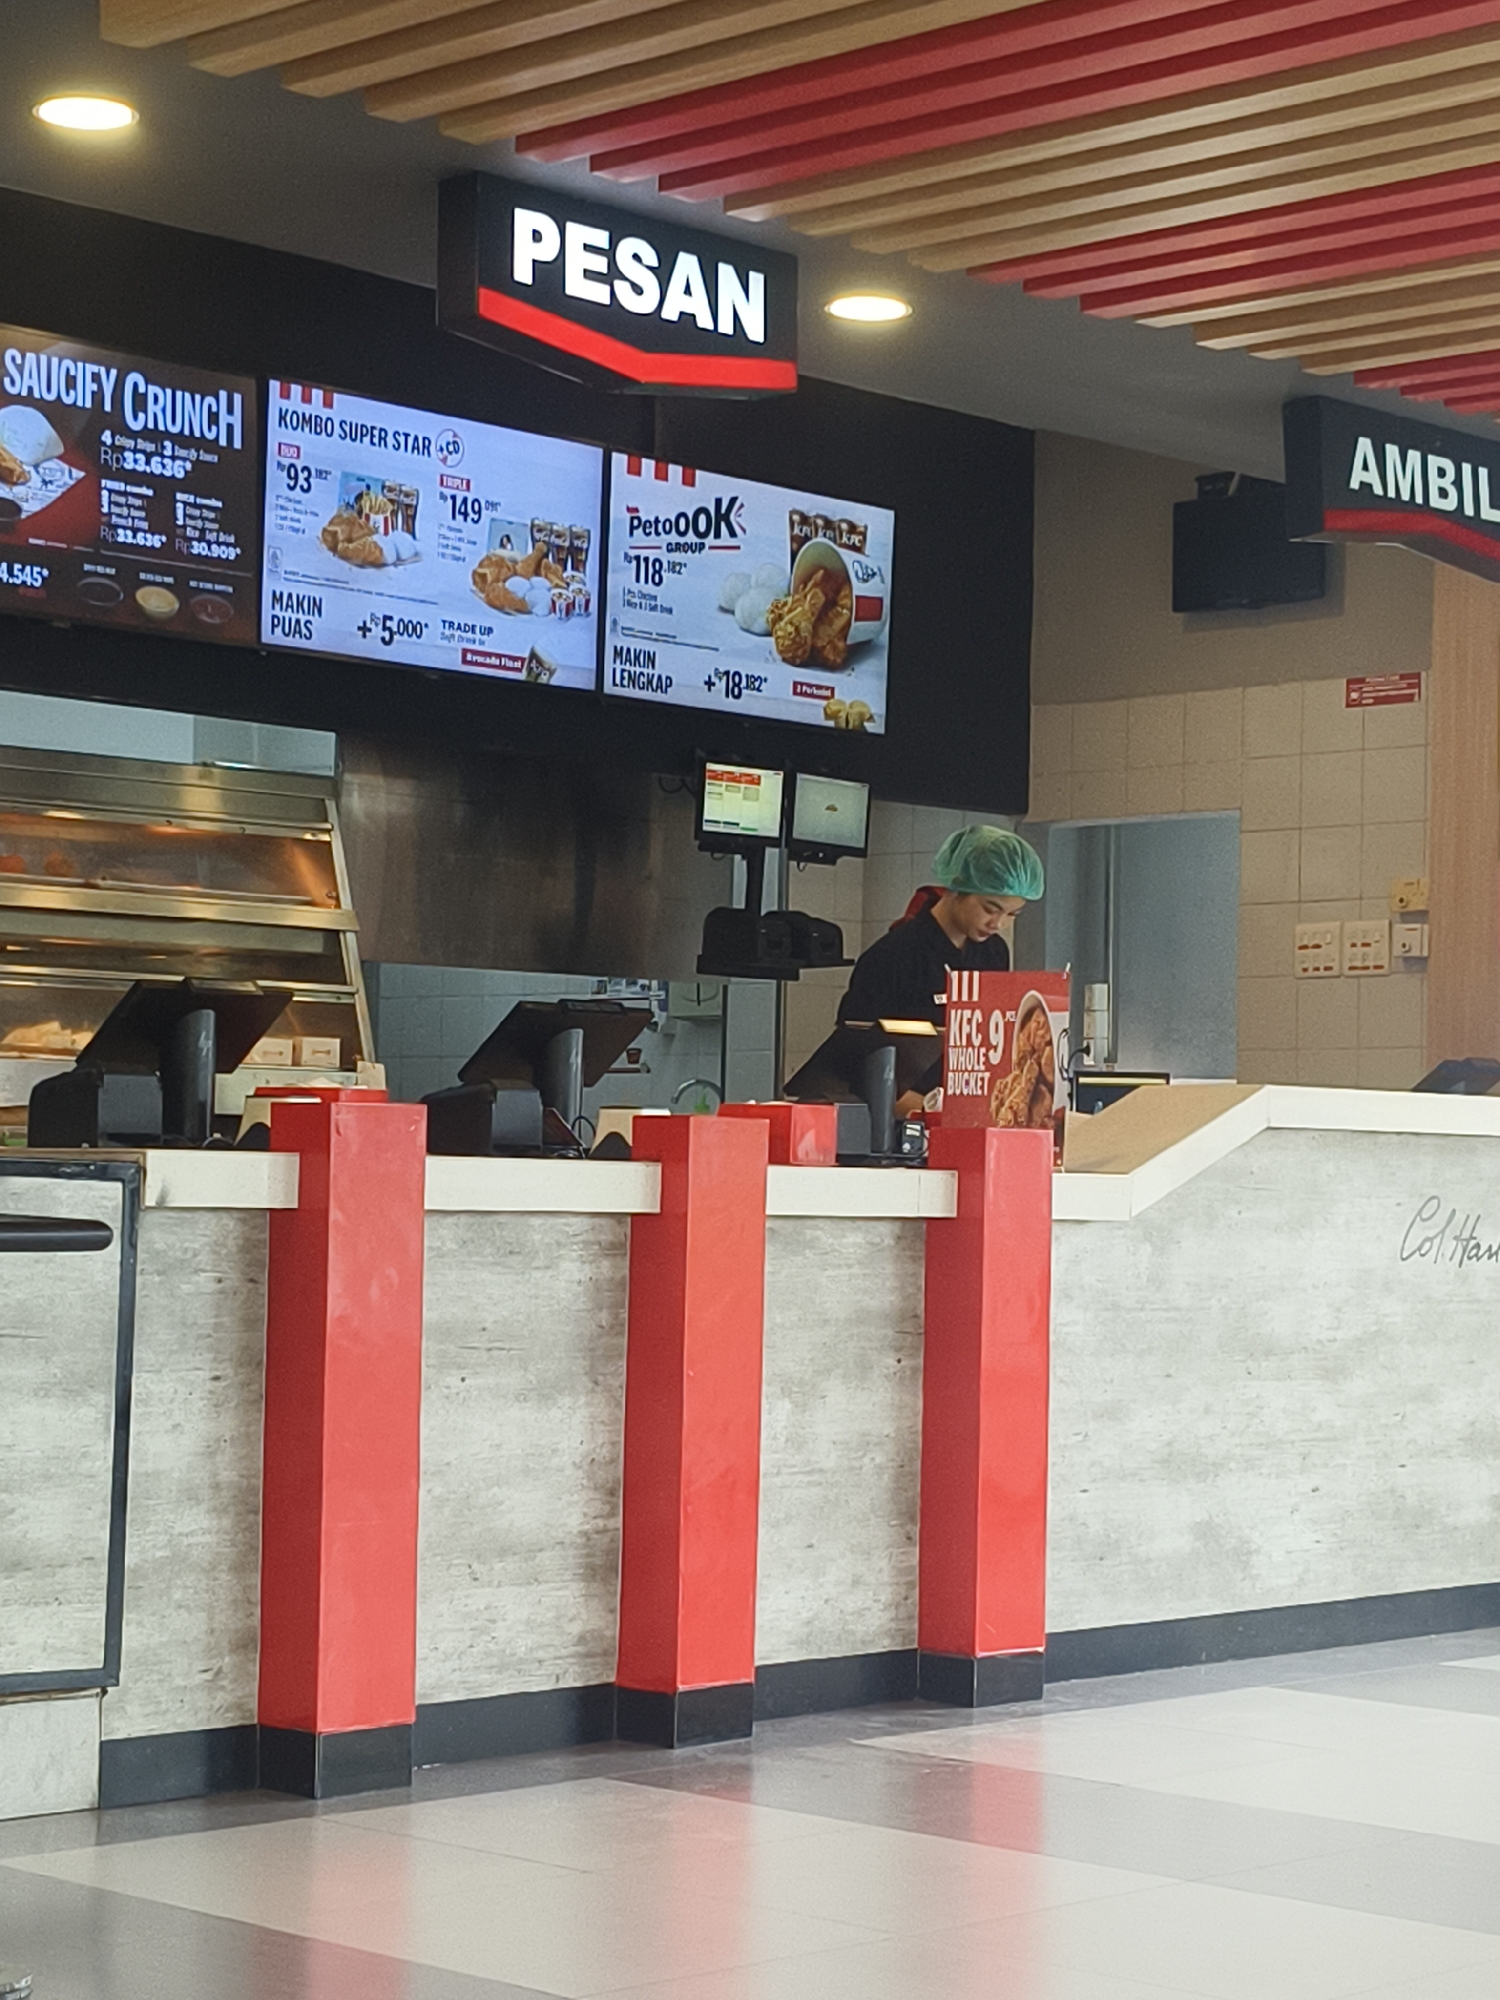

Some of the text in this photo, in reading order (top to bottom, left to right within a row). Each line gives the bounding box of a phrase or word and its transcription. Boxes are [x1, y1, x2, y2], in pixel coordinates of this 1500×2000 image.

[512, 207, 765, 344] PESAN
[4, 348, 242, 449] SAUCIFY CRUNCH
[278, 407, 431, 458] KOMBO SUPER STAR
[1349, 436, 1500, 523] AMBIL
[666, 541, 706, 554] GROUP
[271, 589, 322, 618] MAKIN
[271, 614, 313, 641] PUAS
[441, 619, 494, 637] TRADE UP
[612, 644, 656, 671] MAKIN
[612, 667, 673, 694] LENGKAP
[949, 1009, 1004, 1066] KFC 9
[949, 1047, 986, 1071] WHOLE
[947, 1072, 990, 1096] BUCKET
